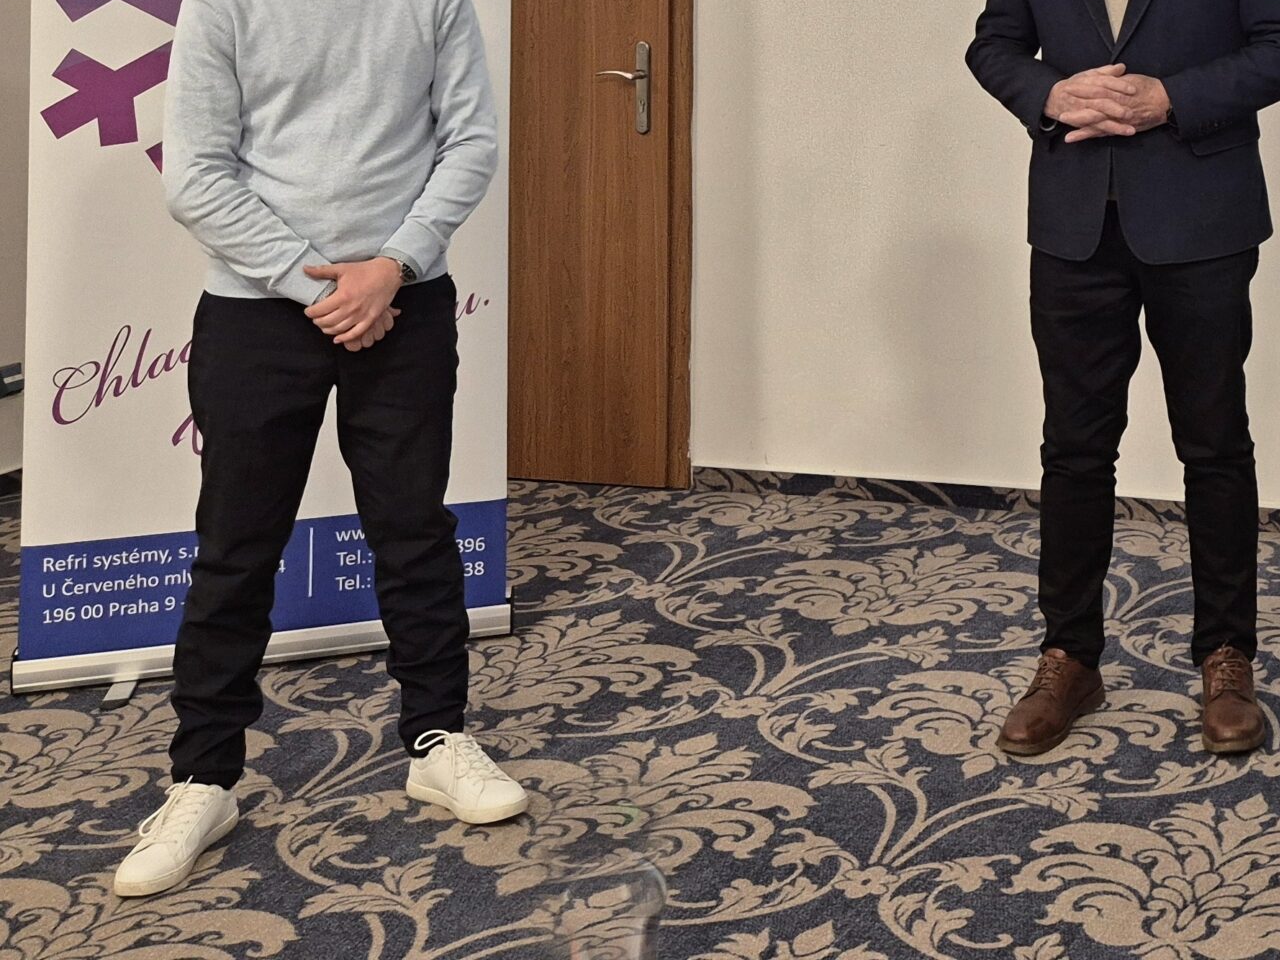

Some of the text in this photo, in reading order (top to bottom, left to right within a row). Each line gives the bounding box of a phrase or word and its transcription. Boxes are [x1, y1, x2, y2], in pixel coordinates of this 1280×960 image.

[42, 546, 199, 573] Refri systémy, s.r
[336, 549, 373, 567] Tel.:
[42, 583, 56, 598] U
[61, 574, 159, 597] Červeného
[335, 561, 485, 591] Tel.: 38
[42, 605, 76, 624] 196
[80, 603, 104, 620] 00
[109, 598, 159, 618] Praha
[164, 596, 176, 612] 9
